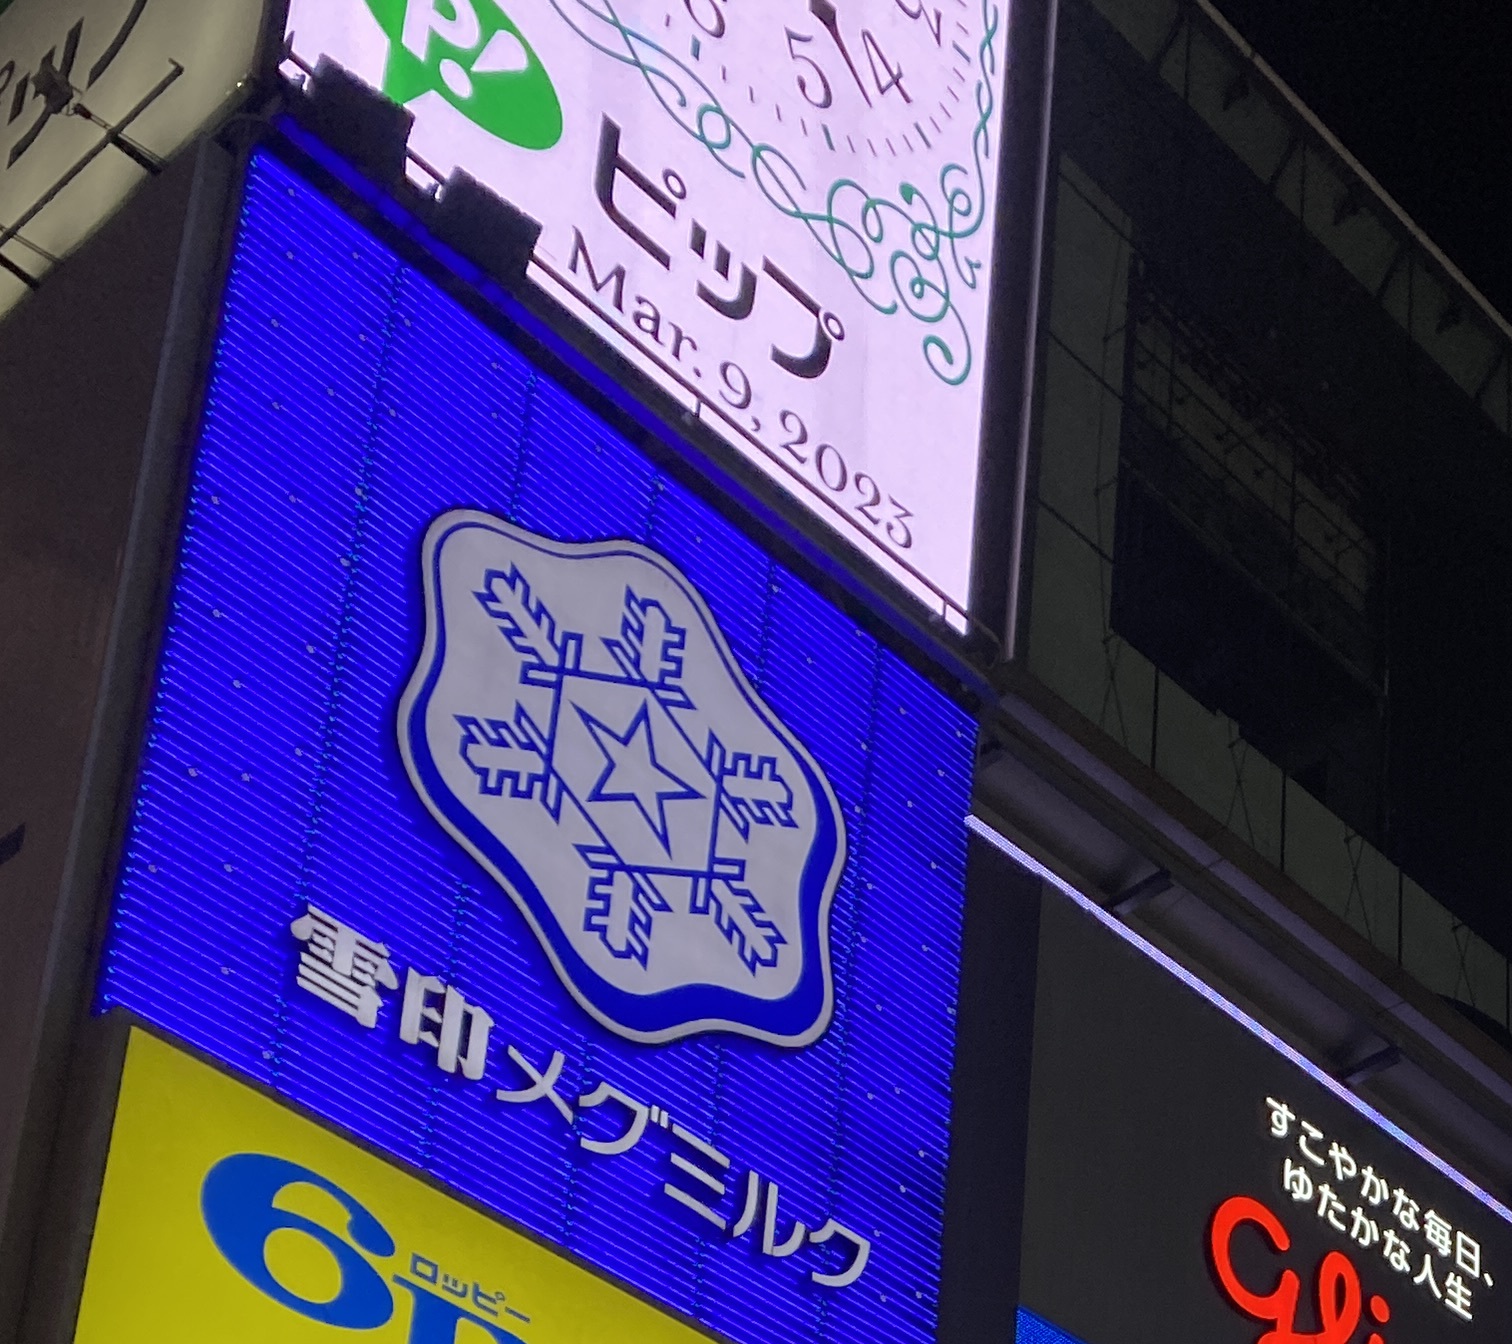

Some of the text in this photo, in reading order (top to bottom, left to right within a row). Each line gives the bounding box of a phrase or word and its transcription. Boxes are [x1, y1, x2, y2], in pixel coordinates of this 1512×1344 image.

[568, 225, 703, 377] Mar.
[594, 113, 846, 380] ピップ
[290, 904, 872, 1287] 雪印メグミルク
[1266, 1097, 1494, 1287] すこやかな毎日、
[1284, 1158, 1473, 1321] ゆたかな人生
[410, 1251, 531, 1323] ロッピー
